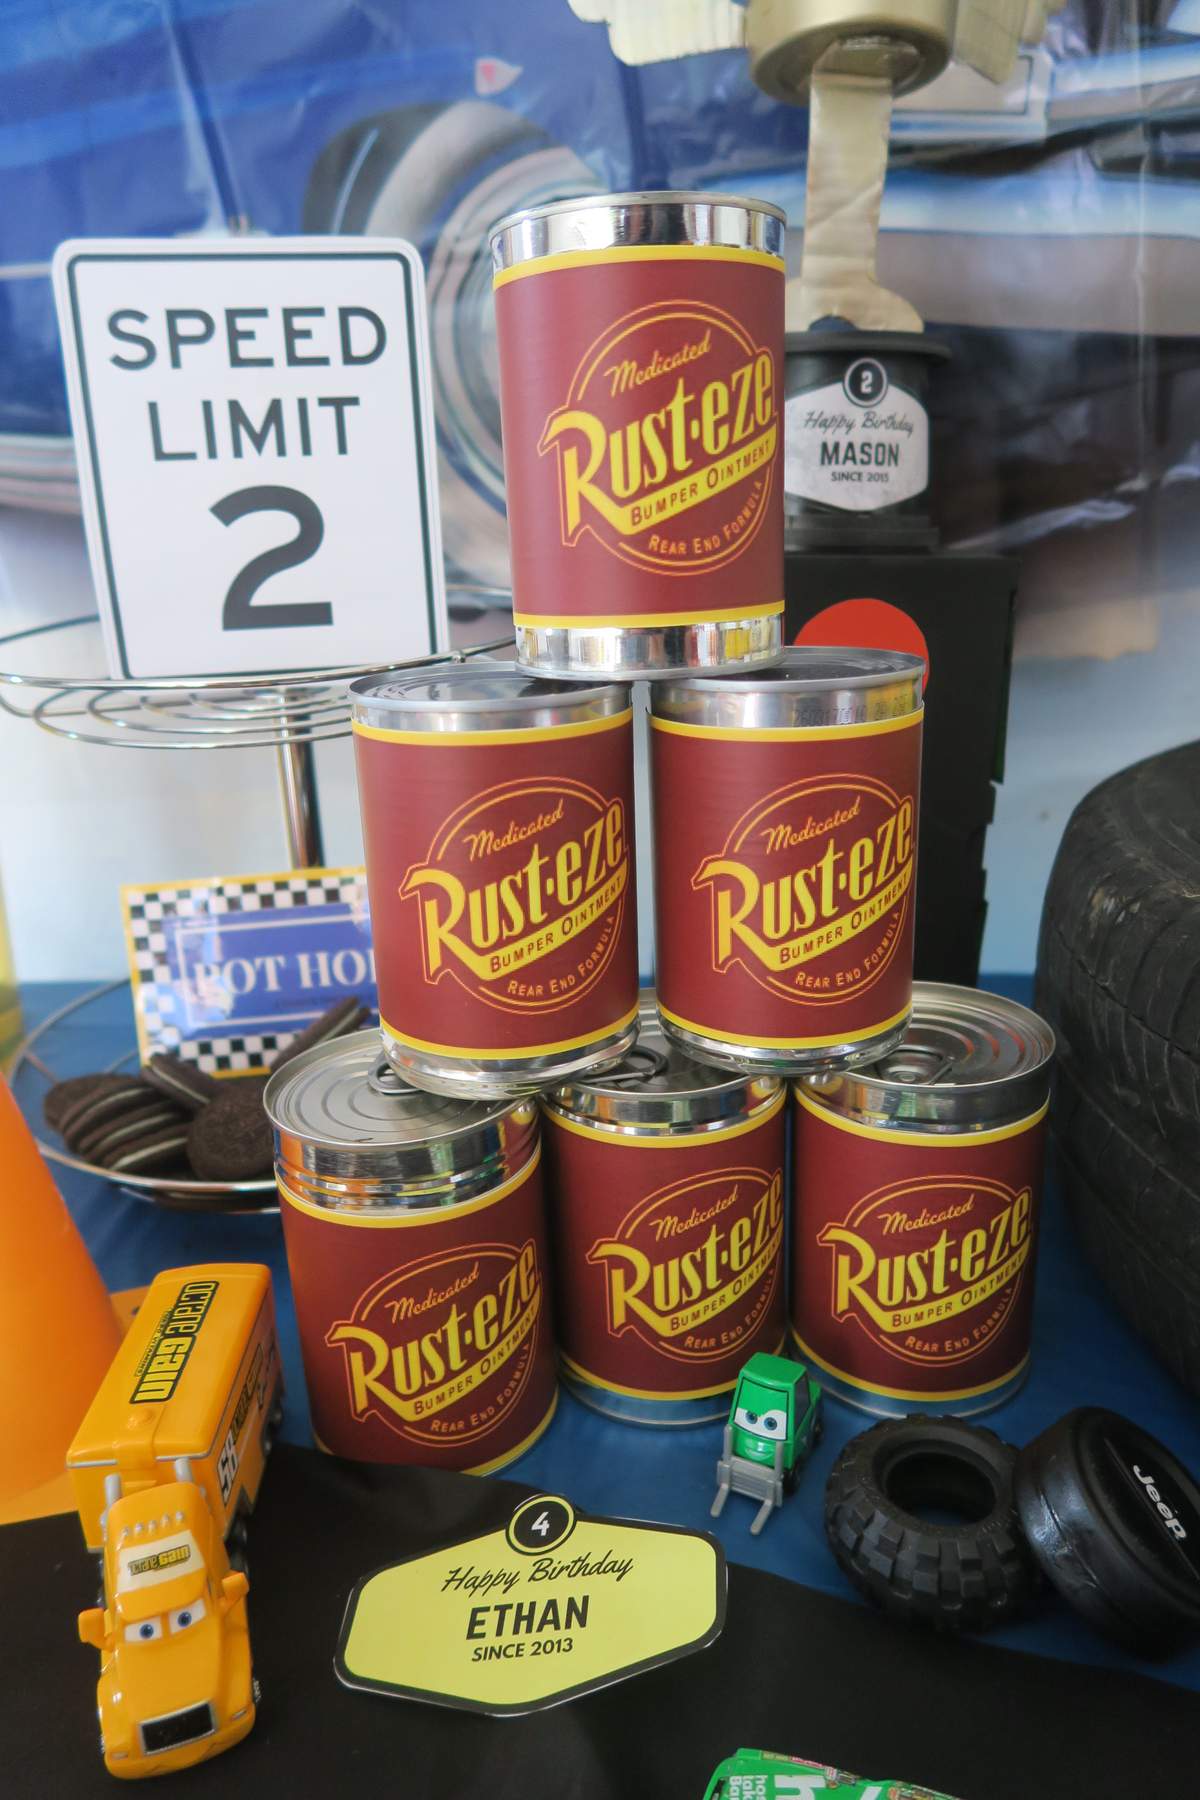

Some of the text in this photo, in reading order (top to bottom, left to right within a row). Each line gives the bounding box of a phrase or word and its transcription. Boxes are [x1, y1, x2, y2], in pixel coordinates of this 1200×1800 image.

[107, 306, 387, 371] SPEED
[604, 329, 711, 397] Medicated
[860, 370, 873, 395] 2
[147, 396, 360, 462] LIMIT
[800, 410, 914, 439] Happy Birthday
[820, 441, 899, 467] MASON
[631, 440, 771, 526] BUMPER OINTMENT
[831, 471, 863, 482] SINCE
[649, 481, 763, 555] REAR END FORMULA
[208, 485, 333, 631] 2
[463, 798, 564, 861] Medicated
[760, 795, 861, 855] Medicated
[490, 876, 621, 973] BUMPER OINTMENT
[780, 926, 843, 964] BUMPER
[795, 911, 900, 988] REAR END FORMULA
[507, 915, 615, 997] REAR END FORMULA
[649, 1184, 738, 1242] Medicated
[877, 1193, 974, 1236] Medicated
[384, 1261, 479, 1323] Medicated
[671, 1294, 726, 1331] BUMPER
[892, 1302, 953, 1328] BUMPER
[905, 1286, 1012, 1352] REAR END FORMULA
[684, 1335, 716, 1349] REAR
[722, 1325, 743, 1344] END
[413, 1375, 473, 1416] BUMPER
[430, 1343, 530, 1433] REAR END FORMULA
[531, 1511, 550, 1537] 4
[1133, 1464, 1186, 1540] Jeep
[440, 1549, 634, 1598] Happy Birthday
[466, 1594, 590, 1640] ETHAN
[471, 1637, 574, 1662] SINCE 2013
